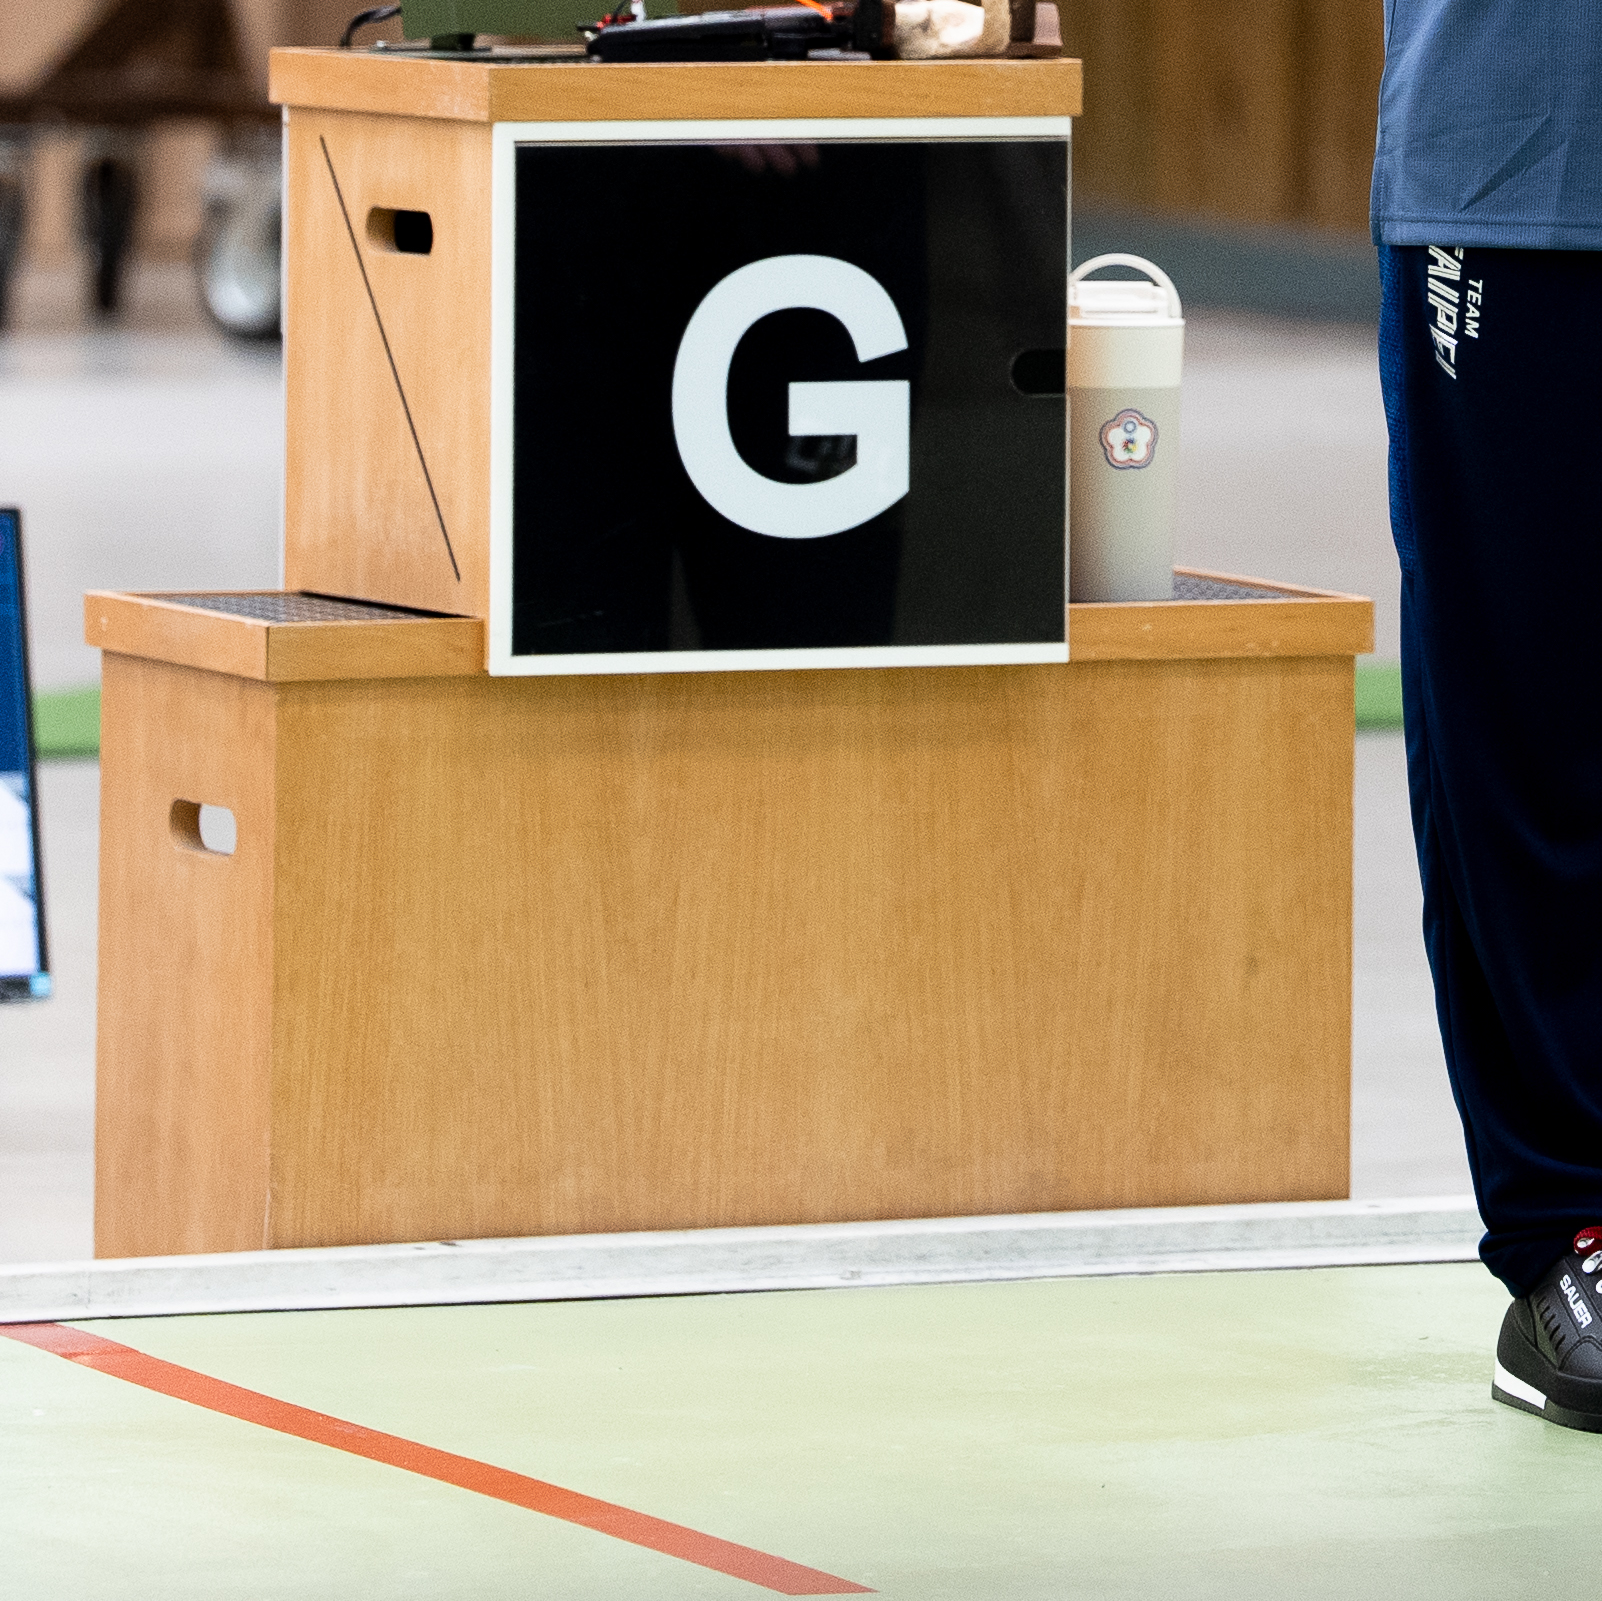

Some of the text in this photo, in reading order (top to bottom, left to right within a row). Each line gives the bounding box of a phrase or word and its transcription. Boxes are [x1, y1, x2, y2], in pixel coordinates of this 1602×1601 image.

[1427, 244, 1464, 380] AIPEI
[1464, 279, 1483, 339] TEAM
[670, 253, 911, 540] G
[1559, 1274, 1593, 1329] SAUER
